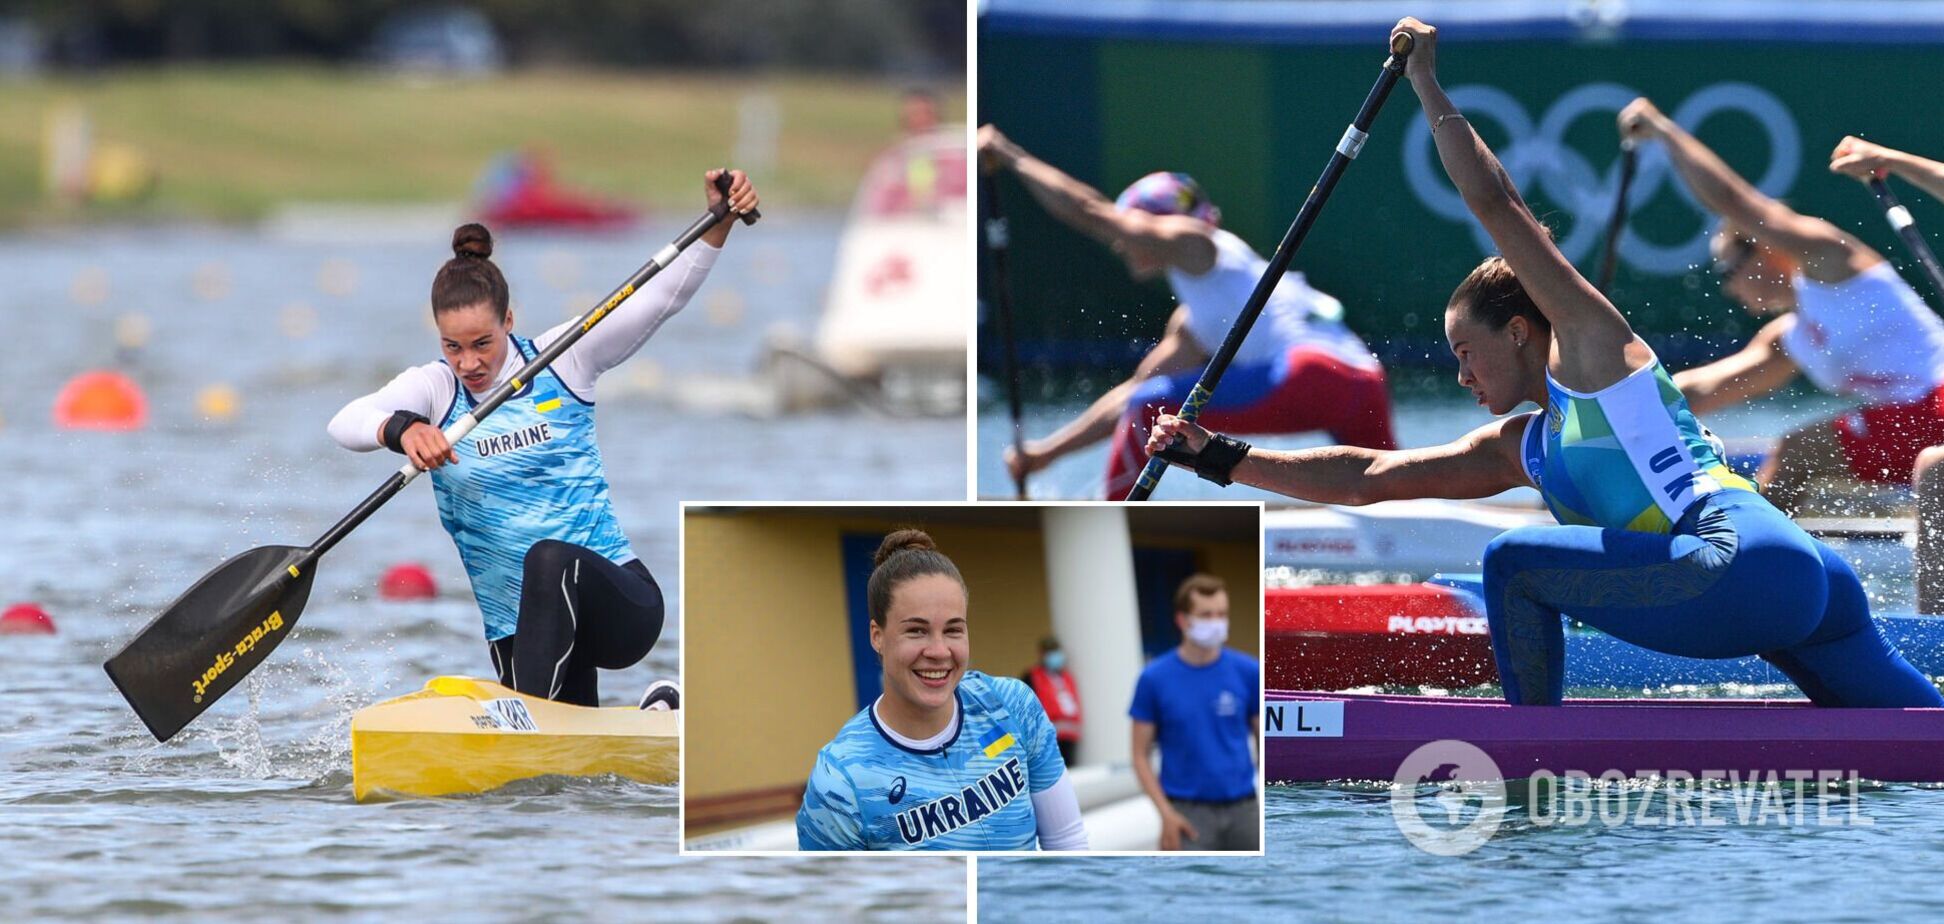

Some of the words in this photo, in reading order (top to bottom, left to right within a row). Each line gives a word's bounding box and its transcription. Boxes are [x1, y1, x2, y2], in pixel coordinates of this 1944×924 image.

[476, 423, 552, 457] UKRAINE
[1649, 446, 1705, 514] UK
[496, 699, 537, 730] UKR
[1297, 706, 1321, 732] L.
[896, 756, 1025, 845] UKRAINE
